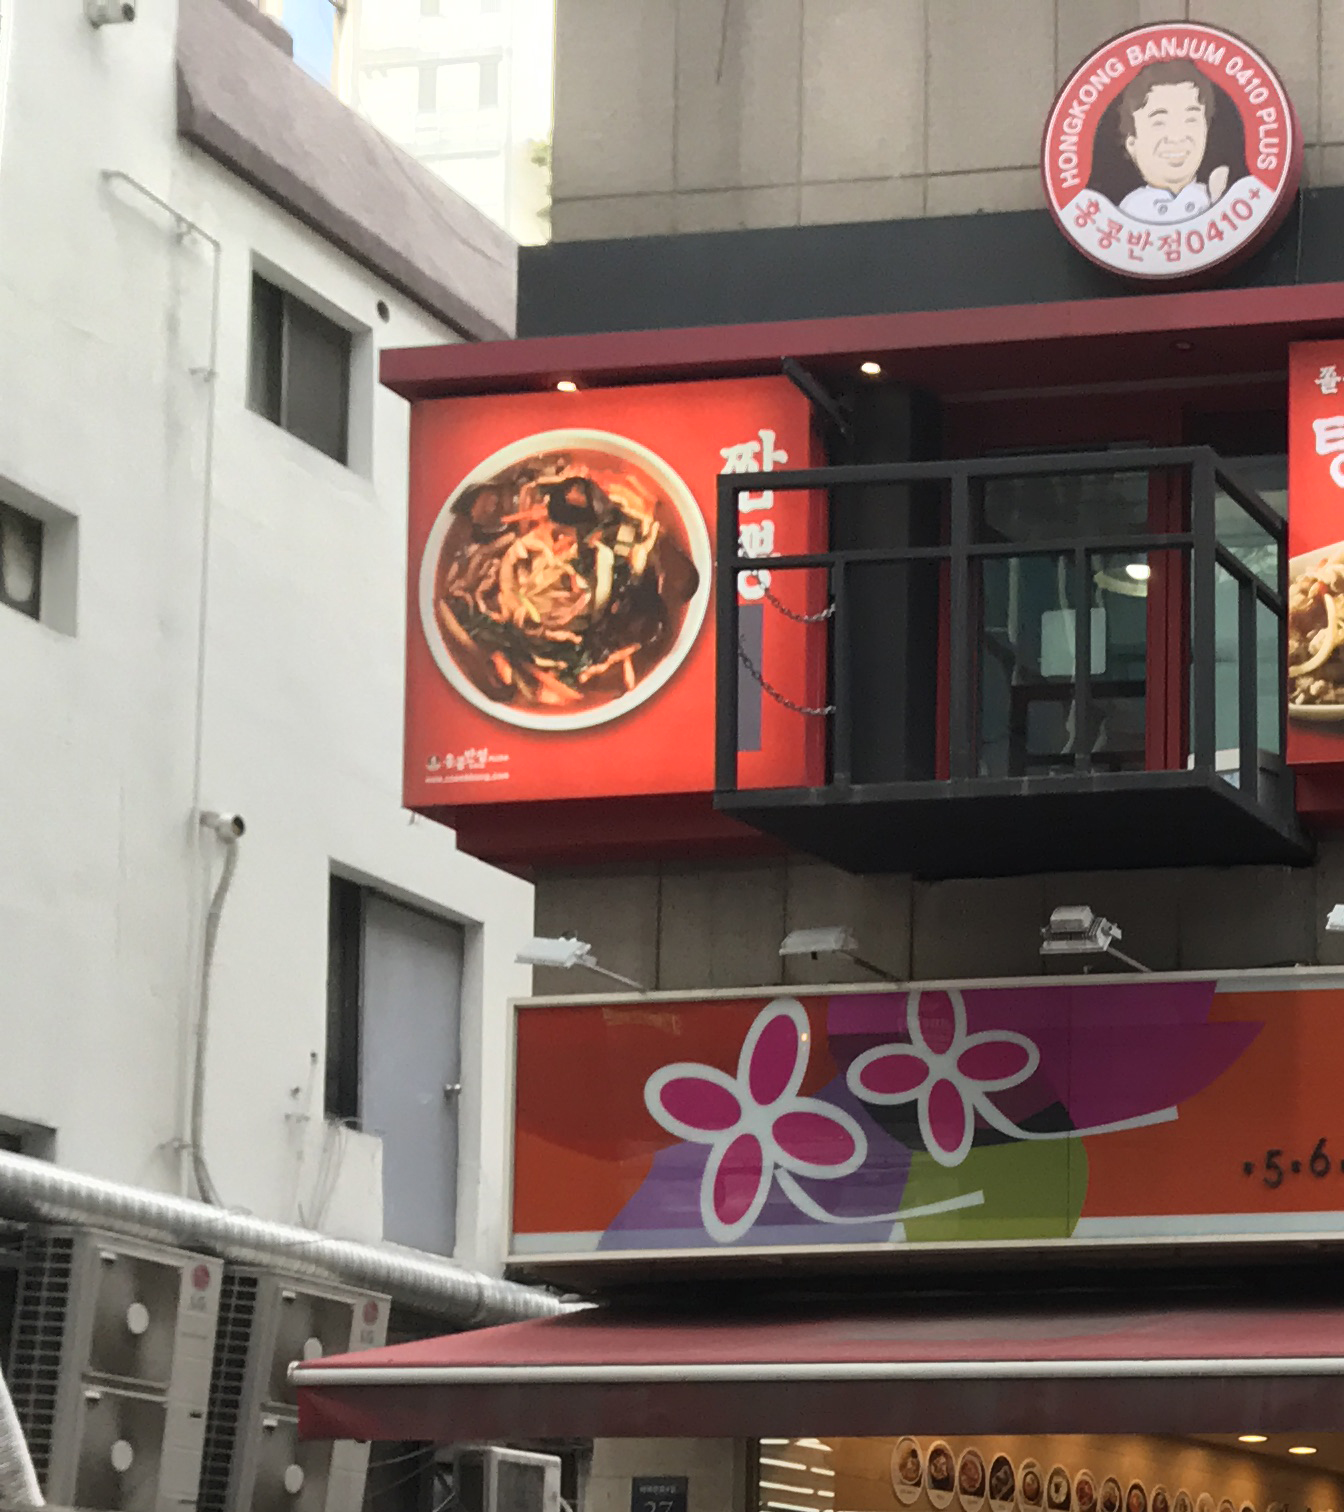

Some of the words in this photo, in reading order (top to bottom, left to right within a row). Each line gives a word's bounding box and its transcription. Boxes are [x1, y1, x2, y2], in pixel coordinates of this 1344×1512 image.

[1057, 57, 1125, 189] HONGKONG
[1125, 36, 1226, 67] BANJUM
[1225, 56, 1270, 105] 0410
[1256, 105, 1279, 171] PLUS
